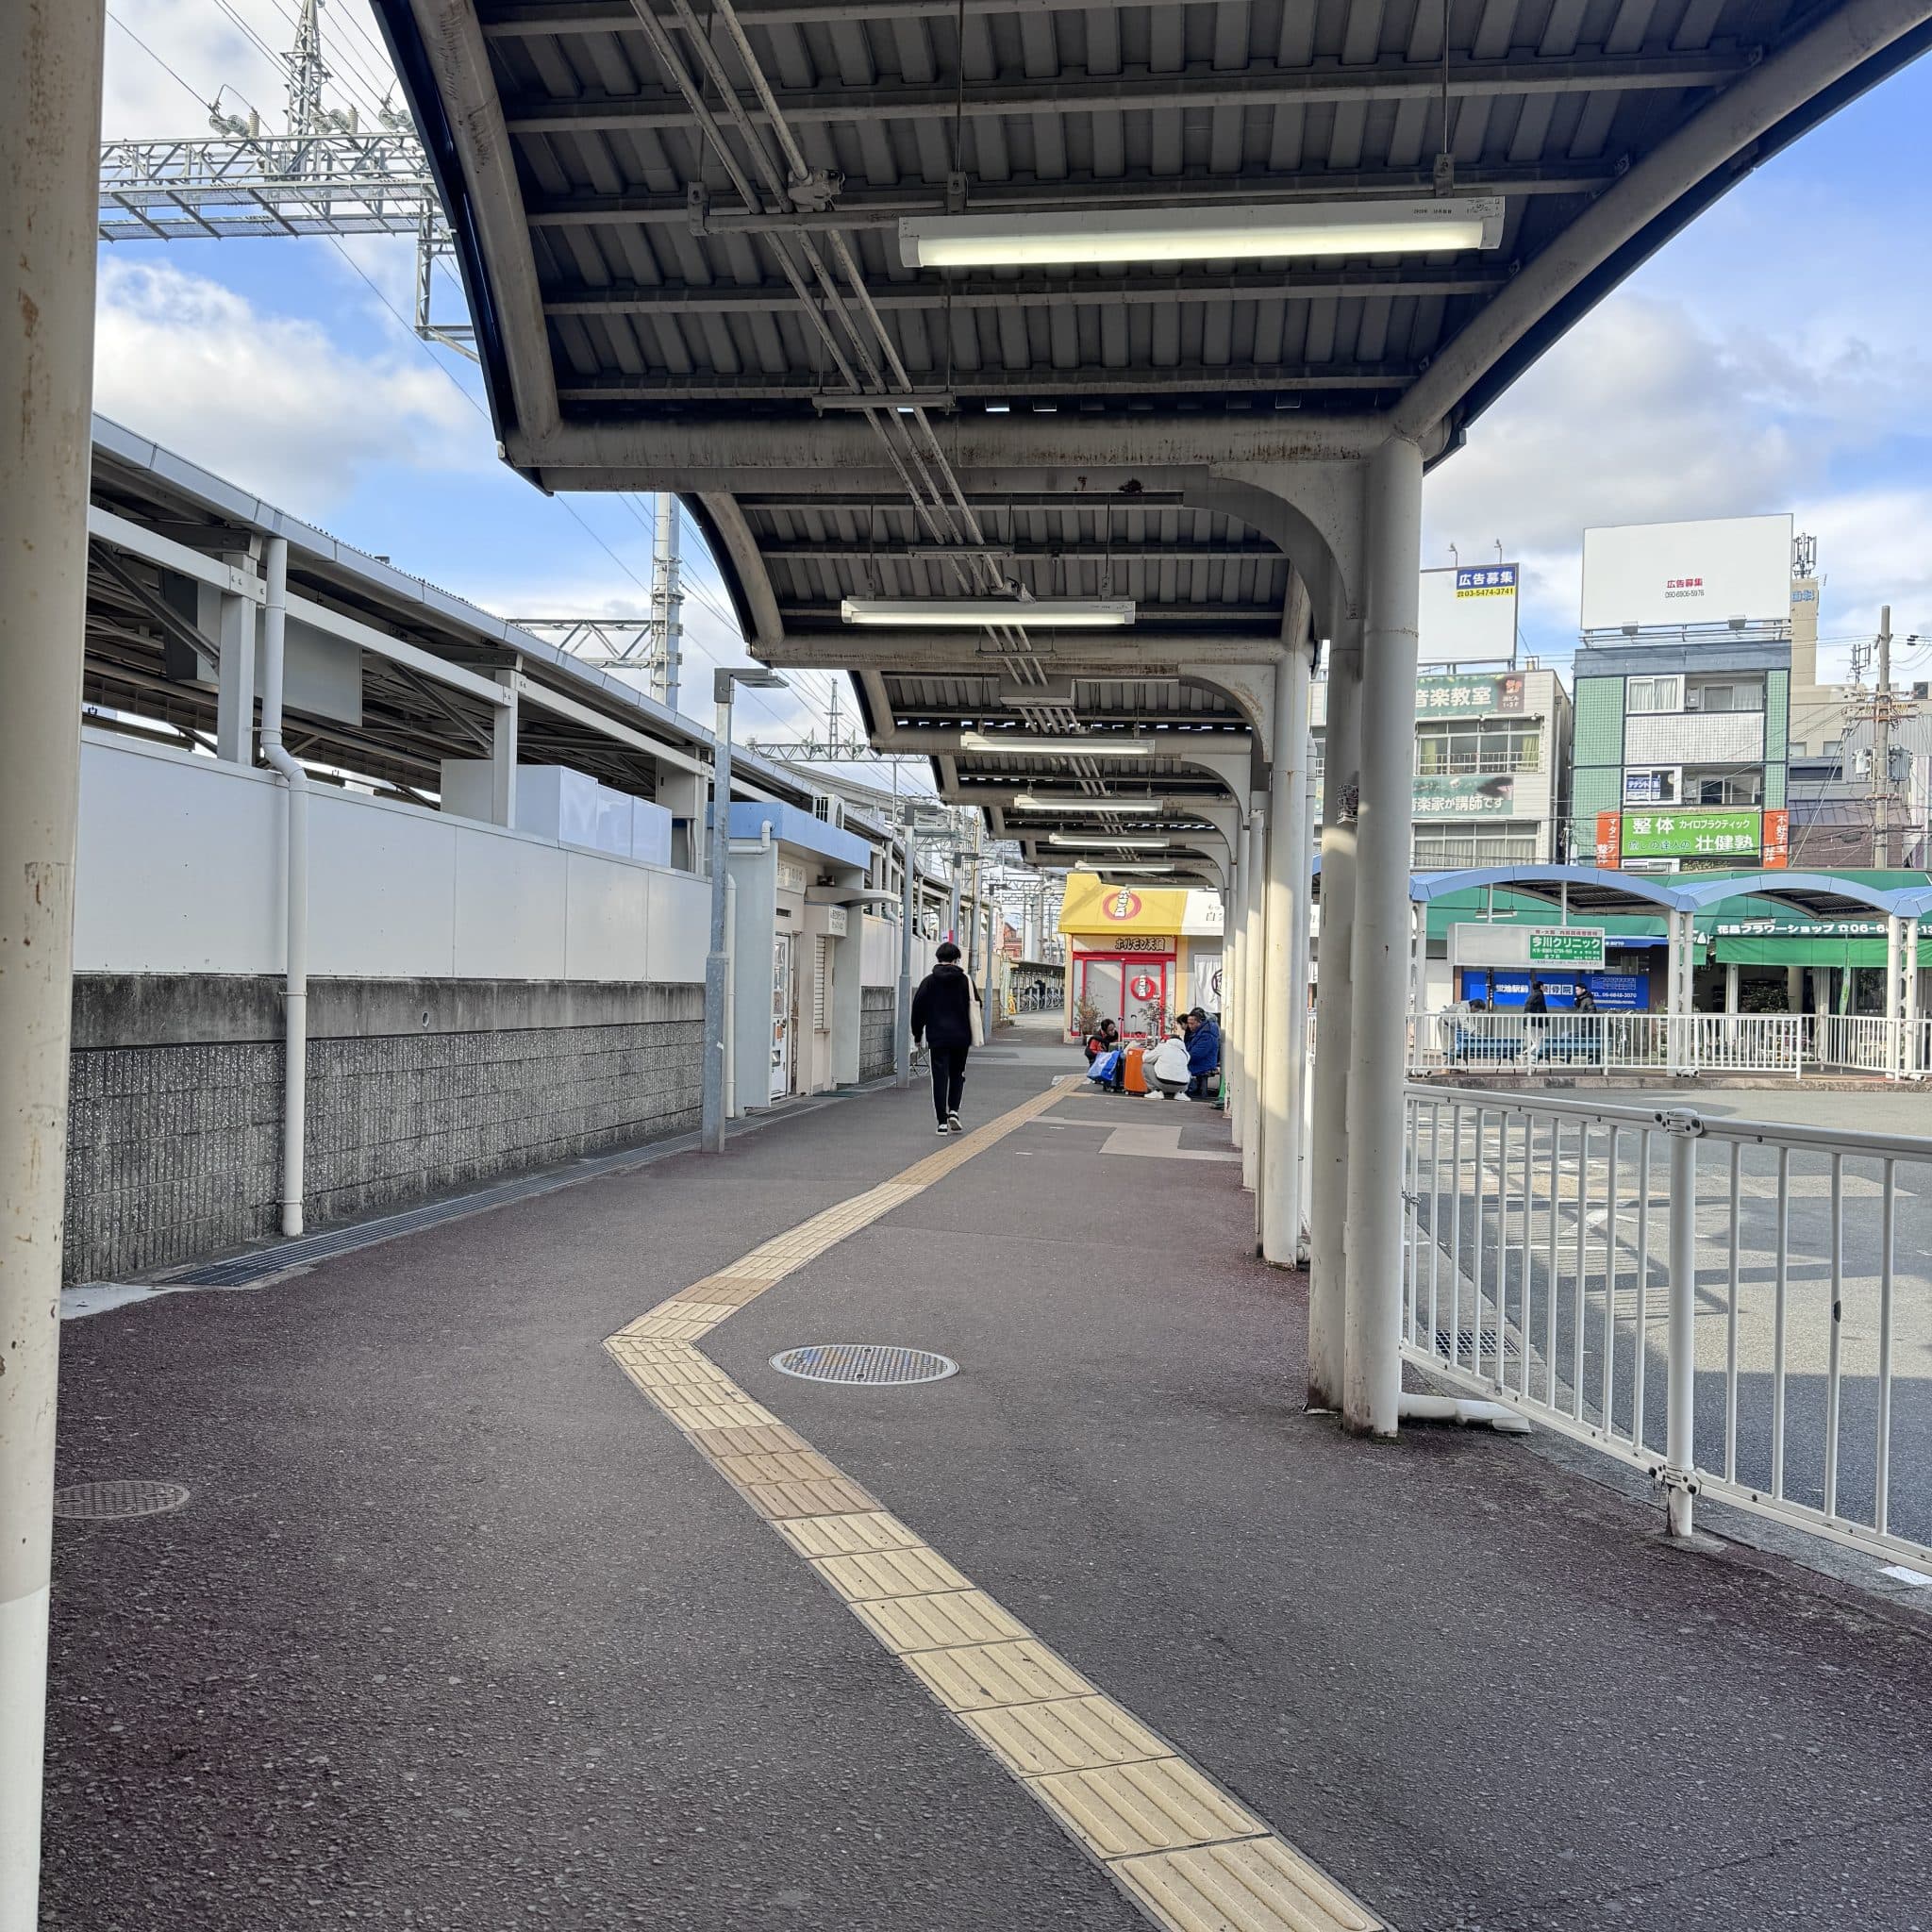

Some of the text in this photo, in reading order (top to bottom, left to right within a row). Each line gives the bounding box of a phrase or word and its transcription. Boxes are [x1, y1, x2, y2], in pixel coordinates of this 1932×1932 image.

[1458, 571, 1513, 587] 広告募集
[1667, 578, 1703, 589] 広告募集
[1632, 817, 1751, 835] 整体 カイロプラクティック
[1532, 936, 1601, 949] 今川クリニック
